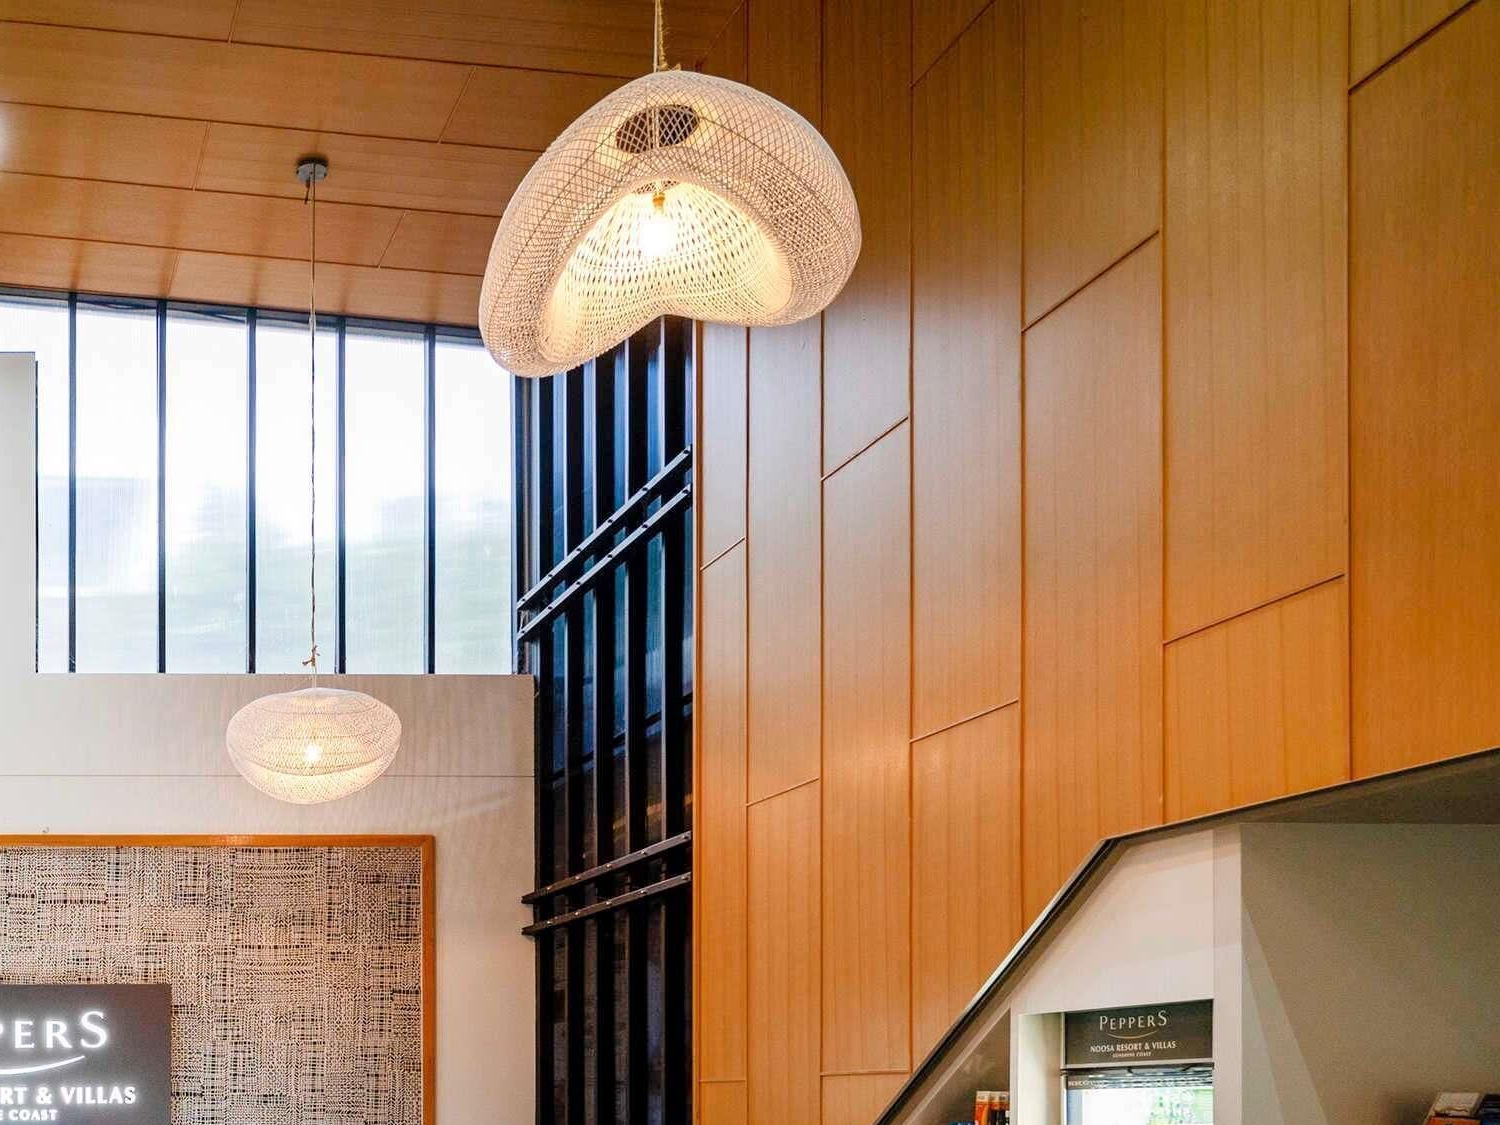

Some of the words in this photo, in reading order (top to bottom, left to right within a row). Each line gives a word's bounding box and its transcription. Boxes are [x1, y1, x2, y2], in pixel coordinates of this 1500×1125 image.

[1100, 1010, 1168, 1031] PEPPERS
[1090, 1044, 1115, 1053] NOOSA
[1116, 1042, 1142, 1052] RESORT
[1144, 1042, 1150, 1050] &
[1152, 1041, 1177, 1050] VILLAS
[35, 1087, 53, 1106] &
[60, 1086, 137, 1105] VILLAS
[9, 1109, 59, 1121] COAST
